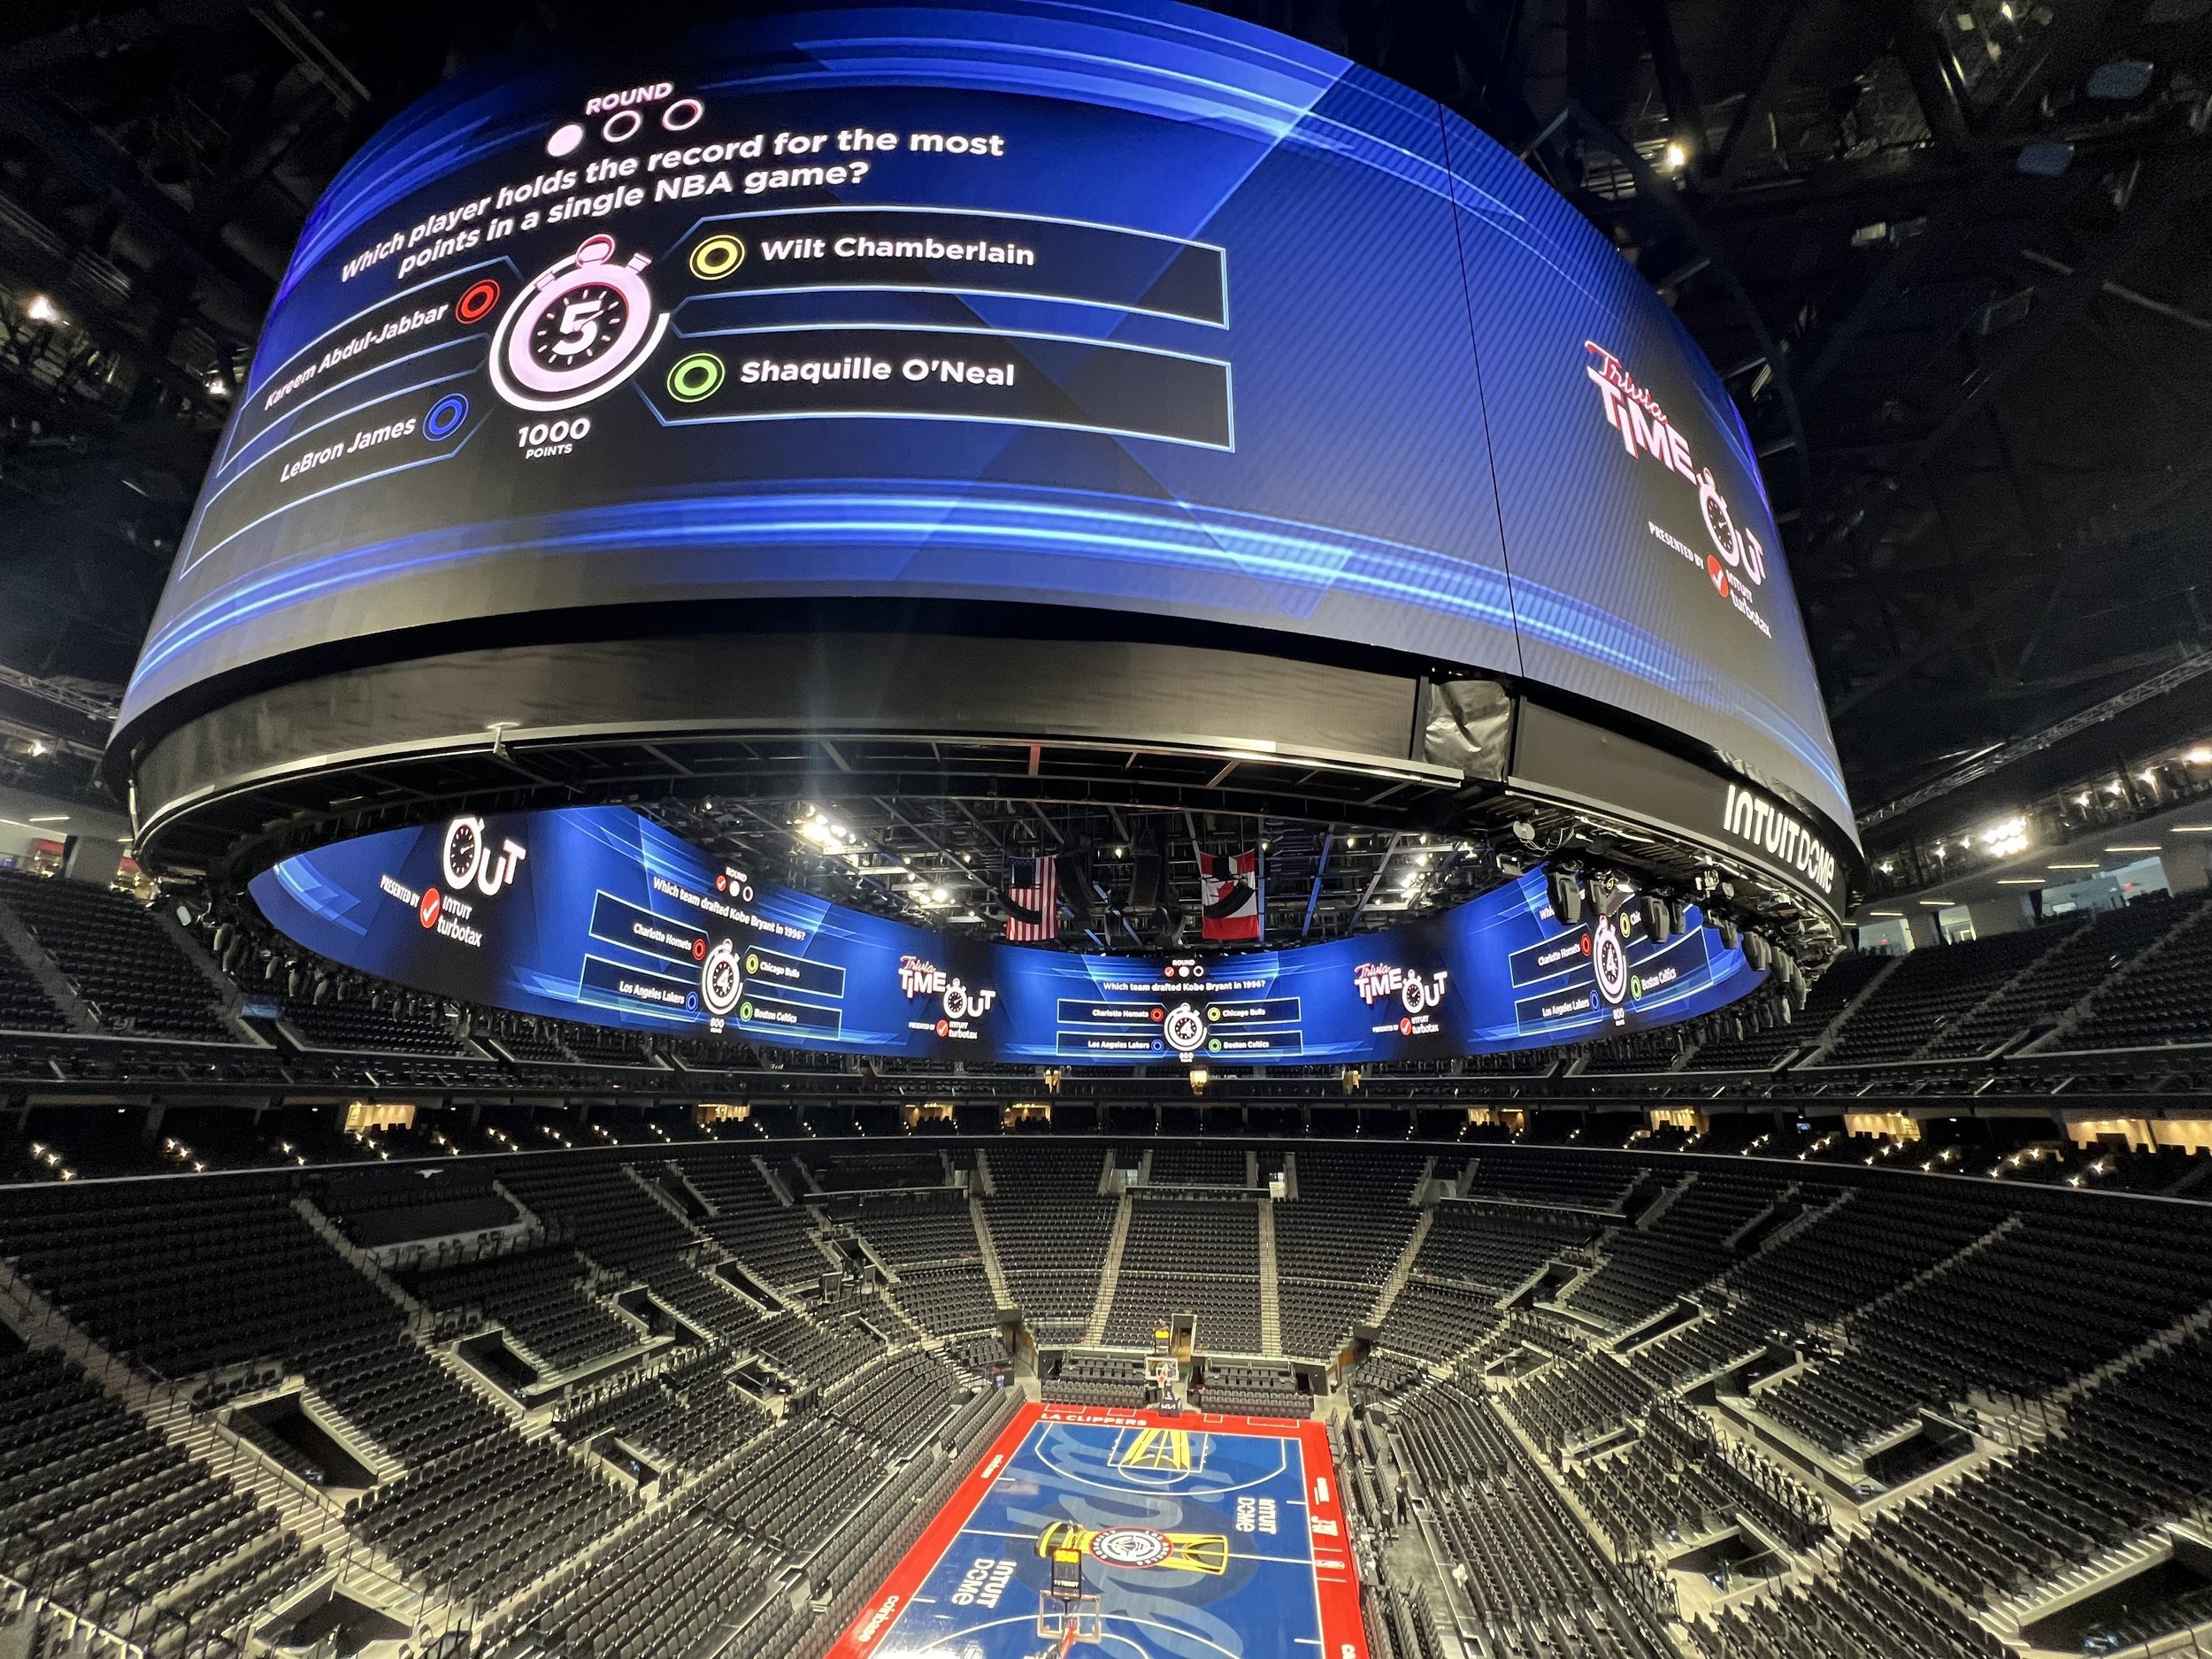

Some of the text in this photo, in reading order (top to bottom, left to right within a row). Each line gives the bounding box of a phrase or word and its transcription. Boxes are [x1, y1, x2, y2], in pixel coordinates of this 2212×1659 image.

[585, 82, 673, 116] ROUND
[341, 128, 1004, 282] Which player holds the record for the most
[397, 161, 870, 280] points in a single NBA game?
[760, 236, 1035, 265] Wilt Chamberlain
[264, 303, 450, 411] Kareem Abdul-Jabbar
[740, 357, 1015, 387] Shaquille O'Neal
[1584, 340, 1670, 425] Trivia
[517, 417, 591, 449] 1000
[1586, 365, 1699, 487] TIME
[279, 417, 417, 483] LeBron James
[525, 443, 573, 460] POINTS
[1647, 520, 1705, 570] PRESENTED BY
[1730, 588, 1773, 639] turbotax
[1724, 784, 1801, 864] INTUIT
[726, 866, 748, 883] ROUND
[380, 874, 420, 909] PRESENTED BY
[442, 895, 473, 920] INTUIT
[653, 876, 806, 941] Which team drafted Kobe Bryant in 1996?
[436, 914, 483, 948] turbotax
[633, 923, 693, 951] Charlotte Hornets
[900, 955, 936, 973] Trivia
[1538, 943, 1581, 966] Charlotte Hornets
[759, 961, 801, 979] Chicago Bulls
[1354, 963, 1391, 979] Trivia
[1641, 966, 1678, 991] Boston Celtics
[619, 980, 686, 1005] Los Angeles Lakers
[898, 968, 947, 999] TIME
[1103, 982, 1129, 991] Which
[1151, 982, 1182, 992] drafted
[1182, 982, 1204, 991] Kobe
[1205, 982, 1233, 992] Bryant
[1242, 980, 1266, 989] 1996?
[1354, 968, 1403, 1005] TIME
[753, 1008, 798, 1025] Boston Celtics
[1092, 1009, 1149, 1018] Charlotte Hornets
[1222, 1008, 1266, 1018] Chicago Bulls
[1542, 997, 1590, 1018] Los Angeles Lakers
[710, 1018, 725, 1028] 800
[948, 1028, 978, 1040] turbotax
[1411, 1024, 1440, 1034] turbotax
[1101, 1041, 1127, 1049] Angeles
[1127, 1041, 1150, 1049] Lakers
[1223, 1040, 1270, 1049] Boston Celtics
[1065, 1415, 1148, 1426] CLIPPERS
[858, 1595, 900, 1643] coinbase
